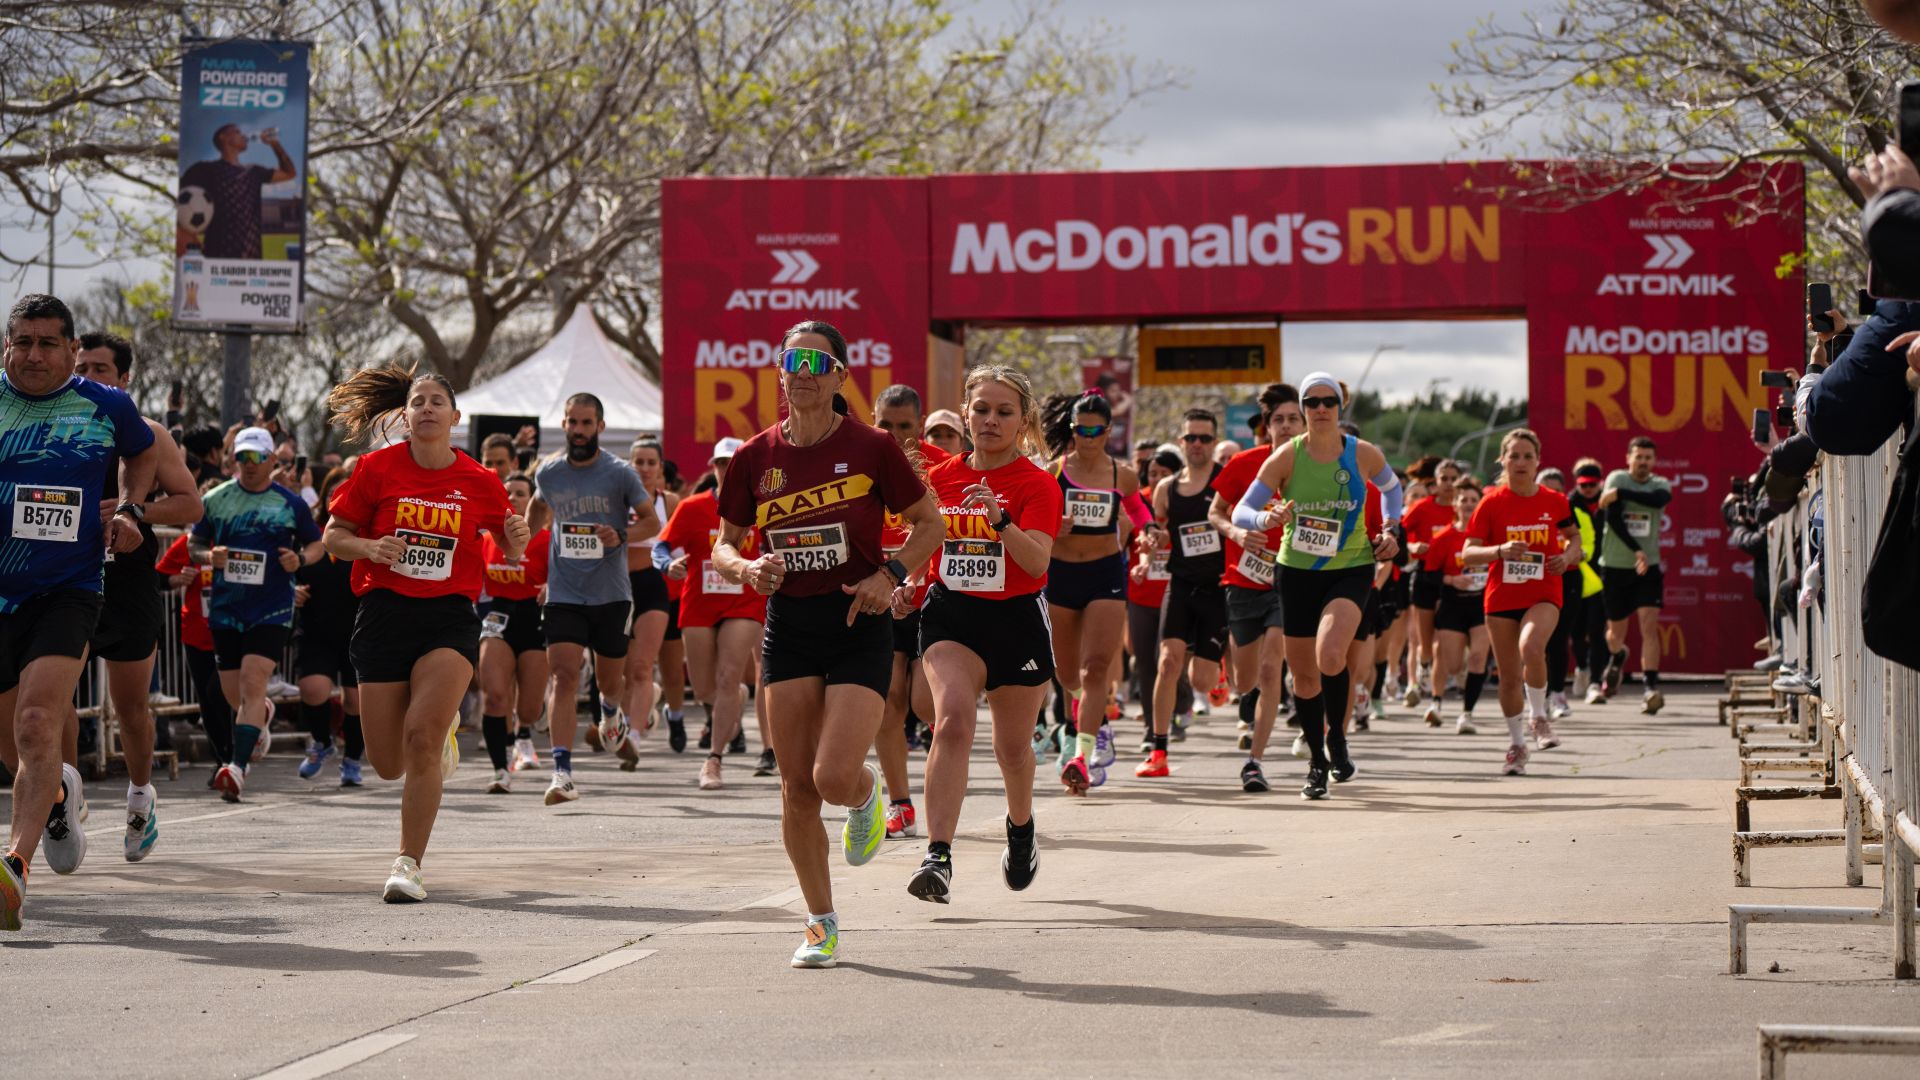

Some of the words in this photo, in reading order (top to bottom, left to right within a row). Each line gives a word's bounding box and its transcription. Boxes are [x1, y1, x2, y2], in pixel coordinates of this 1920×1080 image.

[201, 58, 256, 70] NUEVA
[200, 70, 288, 87] POWERADE
[202, 87, 285, 108] ZERO
[1629, 219, 1658, 229] MAIN
[1660, 219, 1714, 229] SPONSOR
[757, 234, 784, 244] MAIN
[787, 234, 839, 244] SPONSOR
[950, 213, 1342, 274] McDonald's
[1347, 204, 1500, 266] RUN
[1596, 274, 1737, 296] ATOMIK
[241, 293, 291, 306] POWER
[725, 289, 860, 310] ATOMIK
[263, 306, 290, 317] ADE
[1565, 325, 1769, 354] McDonald's
[695, 340, 892, 368] McDd's
[1564, 355, 1769, 432] RUN
[694, 368, 892, 444] RN
[45, 493, 66, 503] RUN
[398, 496, 462, 512] McDonald's
[766, 481, 848, 521] AATT
[23, 505, 73, 528] B5776
[395, 502, 462, 535] RUN
[1072, 503, 1106, 518] B5102
[420, 537, 439, 547] RUN
[565, 536, 597, 550] B6518
[800, 535, 822, 545] RUN
[1186, 533, 1213, 548] B5713
[1298, 529, 1333, 546] B6207
[1506, 529, 1549, 546] RUN
[966, 543, 985, 554] RUN
[228, 561, 259, 575] B6957
[783, 549, 839, 571] B5258
[946, 558, 997, 578] B5899
[487, 569, 525, 584] RUN
[1508, 563, 1538, 576] B5687
